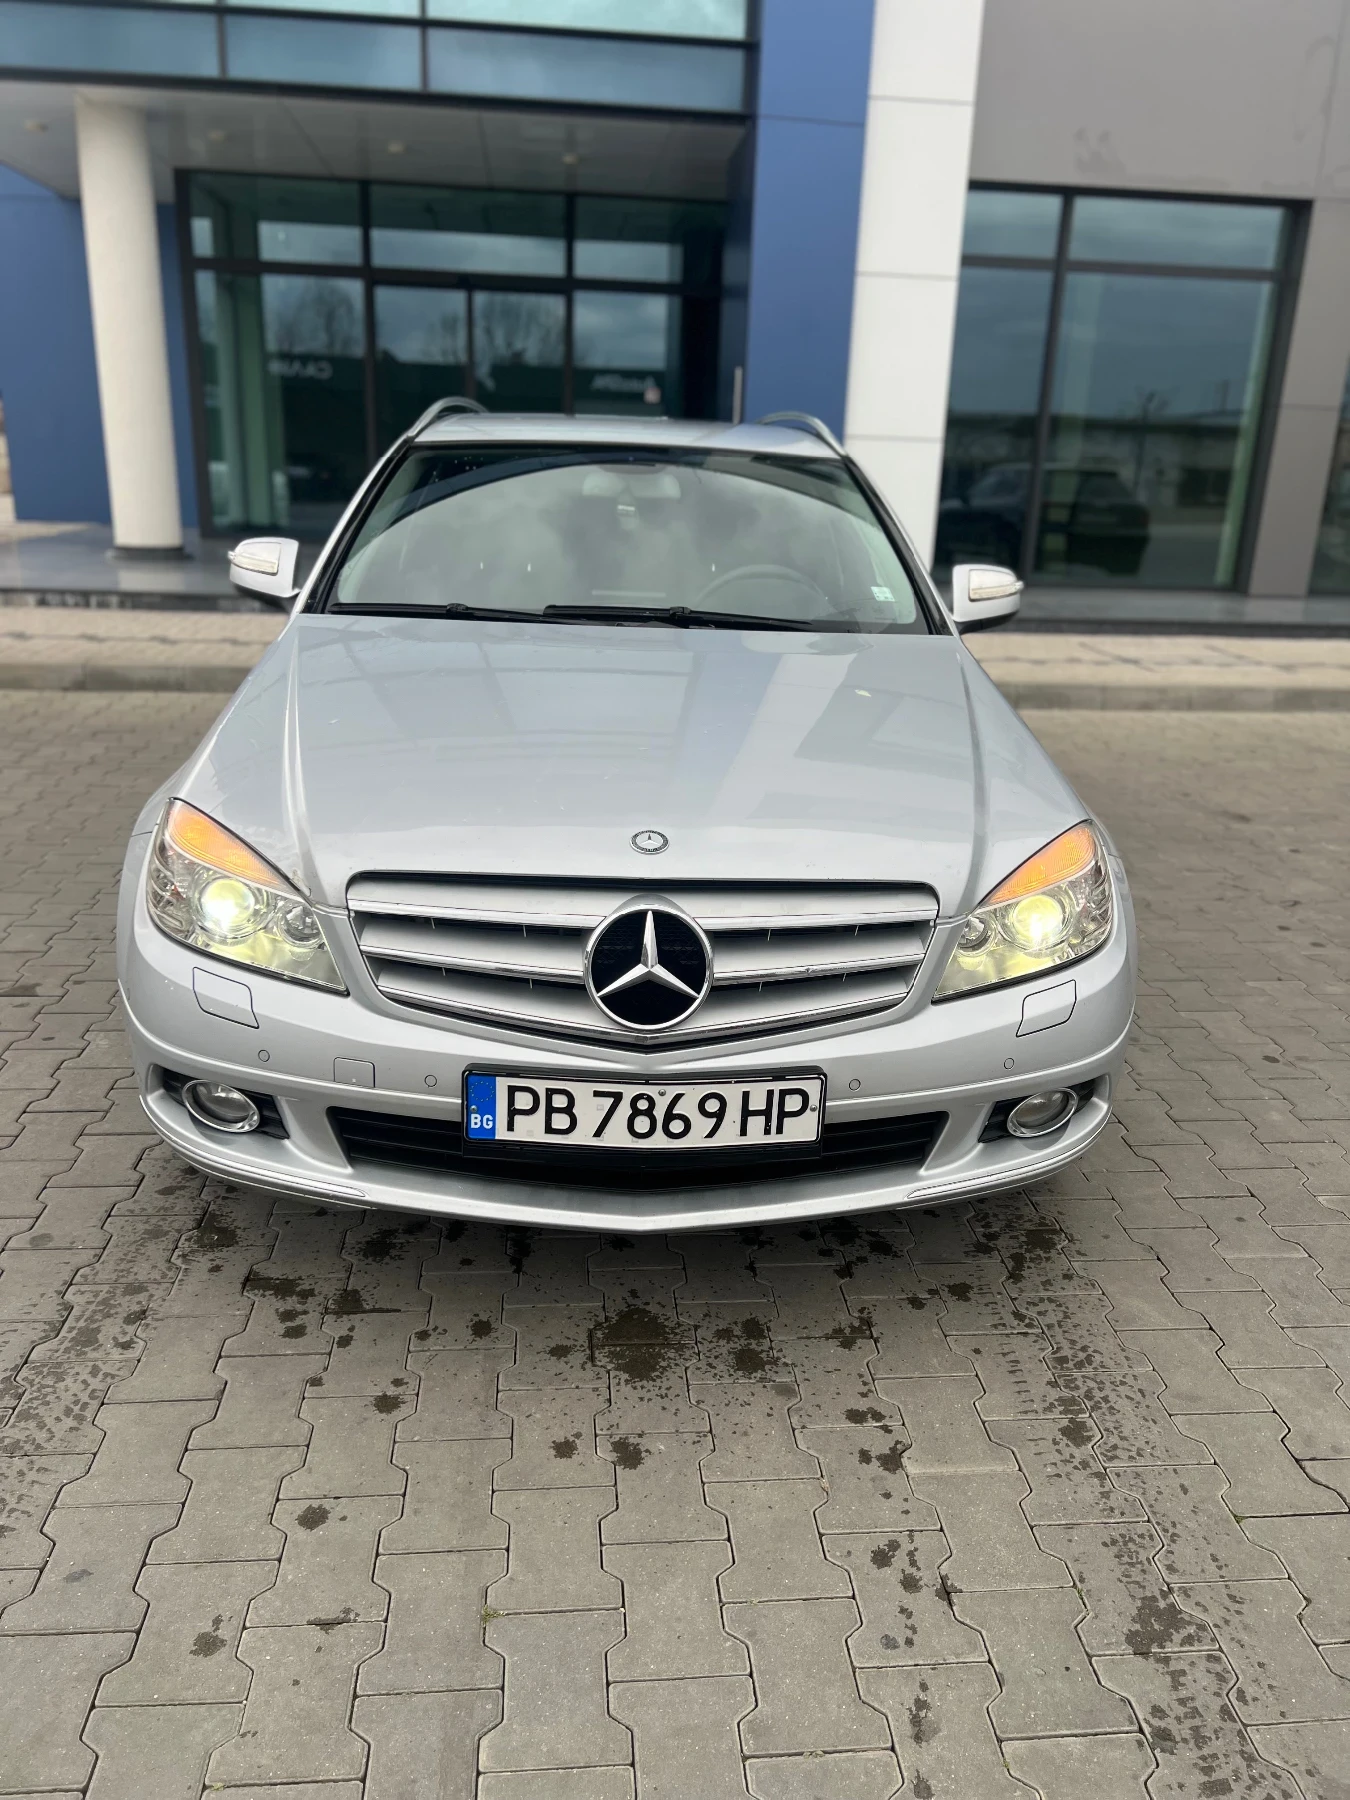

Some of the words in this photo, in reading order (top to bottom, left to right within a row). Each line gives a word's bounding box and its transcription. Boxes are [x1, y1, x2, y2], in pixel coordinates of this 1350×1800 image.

[470, 1114, 494, 1130] BG
[506, 1084, 578, 1136] PB
[592, 1089, 728, 1140] 7869
[739, 1087, 810, 1137] HP
